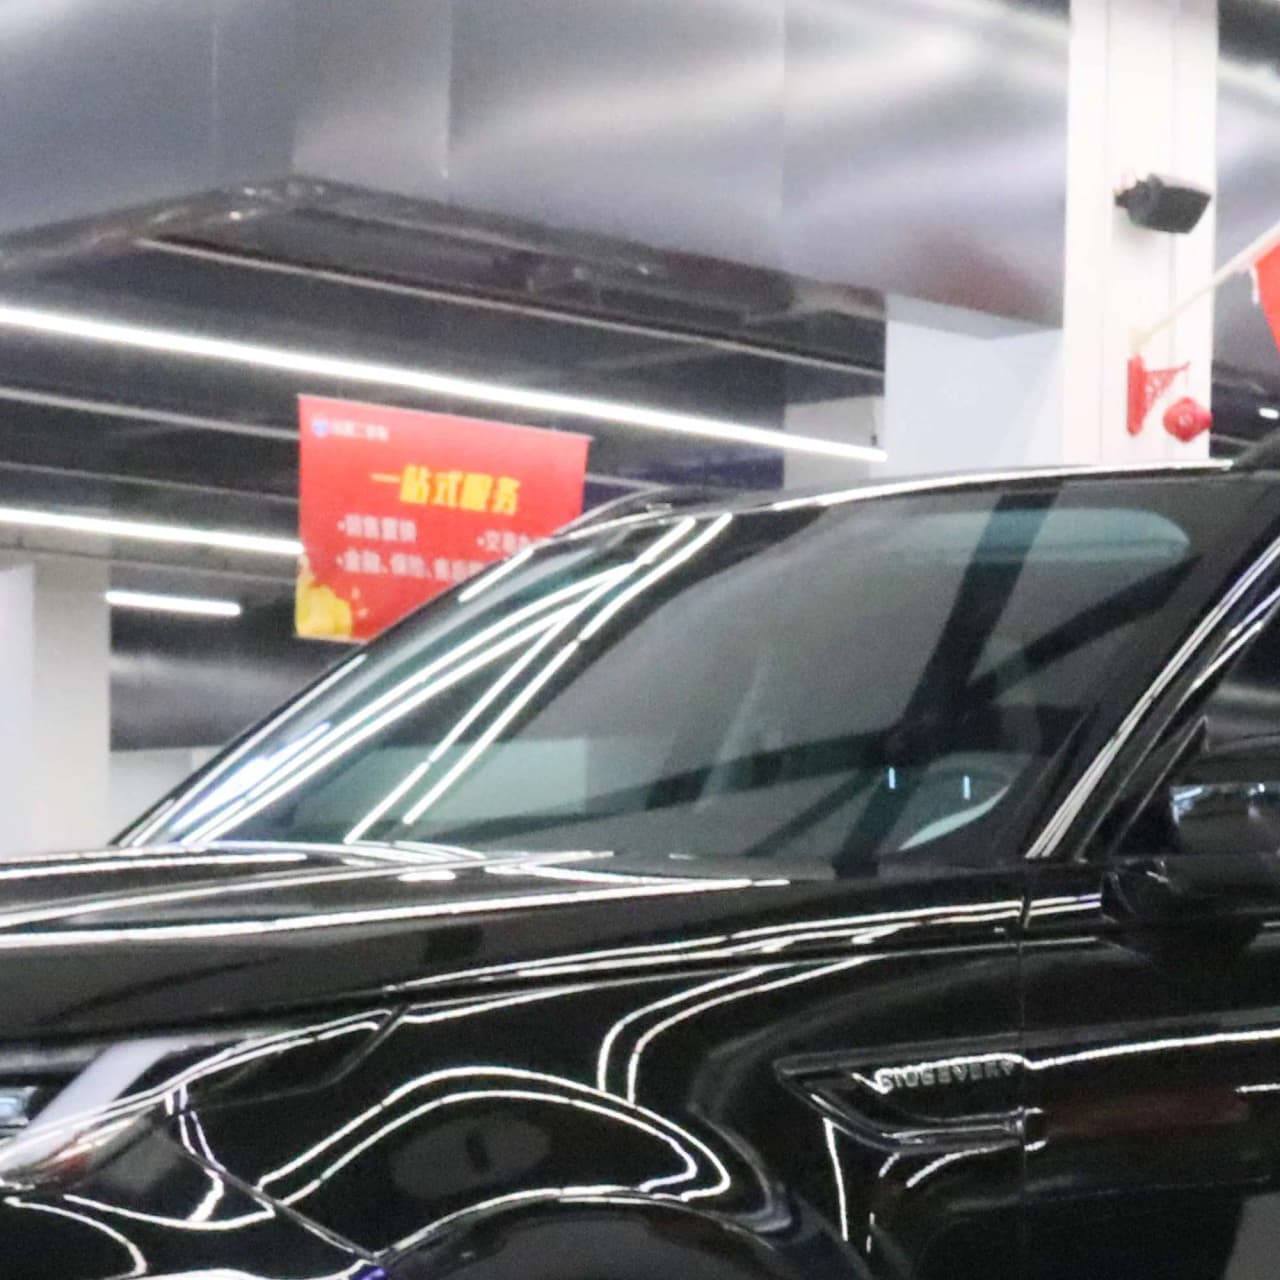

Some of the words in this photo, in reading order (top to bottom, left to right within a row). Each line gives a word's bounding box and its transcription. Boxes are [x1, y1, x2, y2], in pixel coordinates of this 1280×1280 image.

[370, 464, 521, 516] 一站式服务
